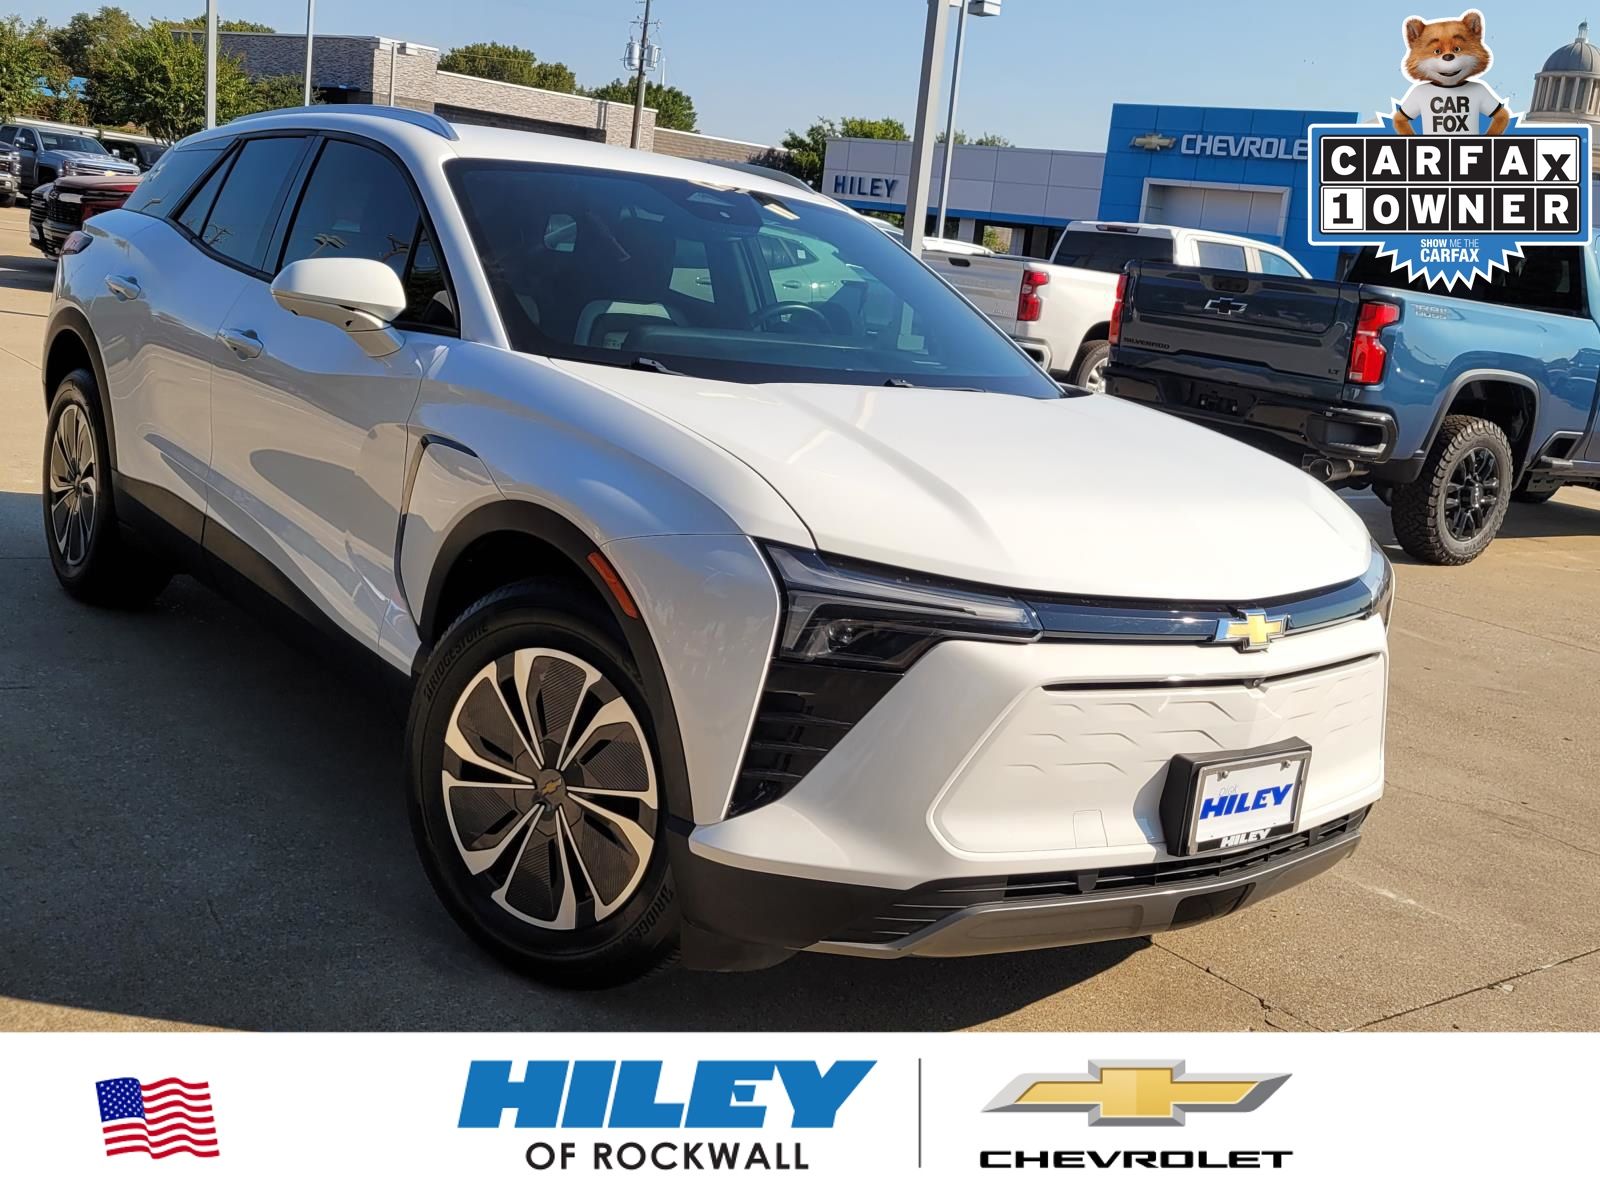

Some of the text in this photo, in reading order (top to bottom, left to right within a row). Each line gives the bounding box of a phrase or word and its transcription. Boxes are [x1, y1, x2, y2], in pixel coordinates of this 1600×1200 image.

[1181, 134, 1308, 160] CHEVROLE
[833, 175, 898, 198] HILEY
[1199, 783, 1294, 820] HILEY
[1219, 828, 1272, 849] HILEY
